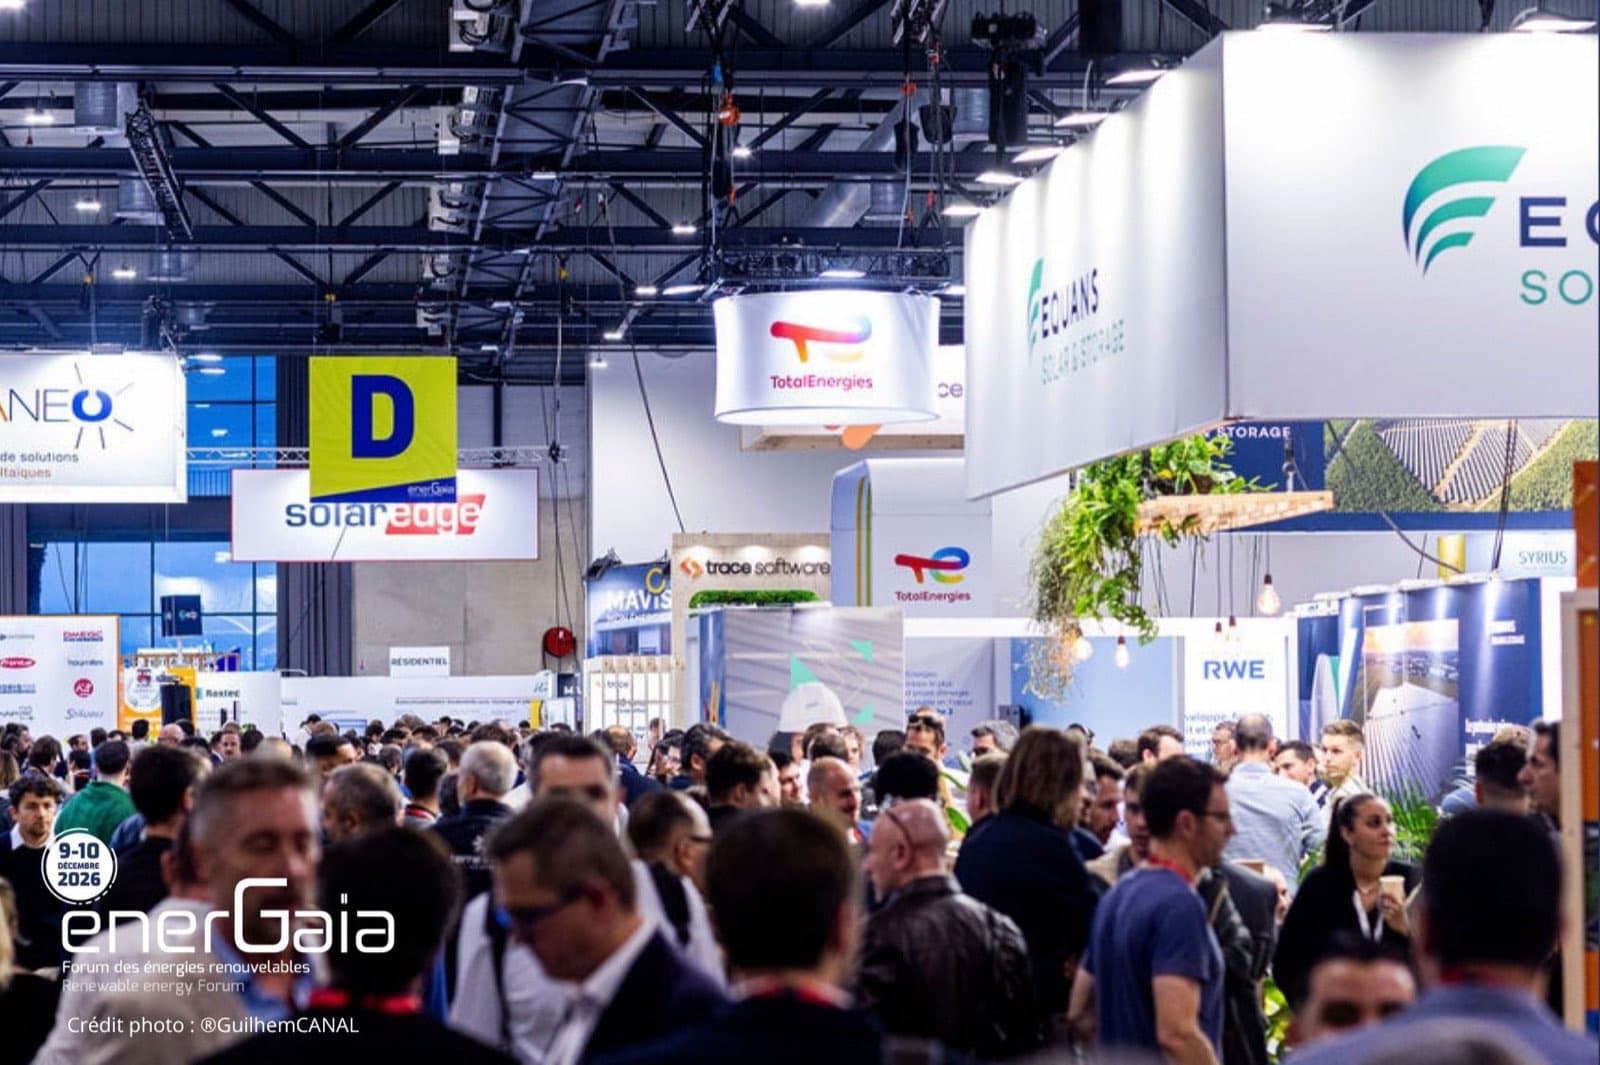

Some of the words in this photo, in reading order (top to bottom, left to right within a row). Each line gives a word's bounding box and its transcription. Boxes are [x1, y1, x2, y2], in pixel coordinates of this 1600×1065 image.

[1519, 196, 1598, 247] E
[1041, 267, 1099, 339] EQUANS
[769, 374, 873, 393] TotalEnergies
[351, 374, 415, 459] D
[0, 452, 16, 462] de
[20, 451, 79, 463] solutions
[285, 500, 481, 535] solaredge
[706, 559, 752, 574] trace
[754, 557, 831, 575] software
[1519, 550, 1568, 565] SYRIUS
[895, 591, 971, 603] TotalEnergies
[391, 655, 447, 667] RÉSIDENTIEL
[1204, 660, 1265, 679] RWE
